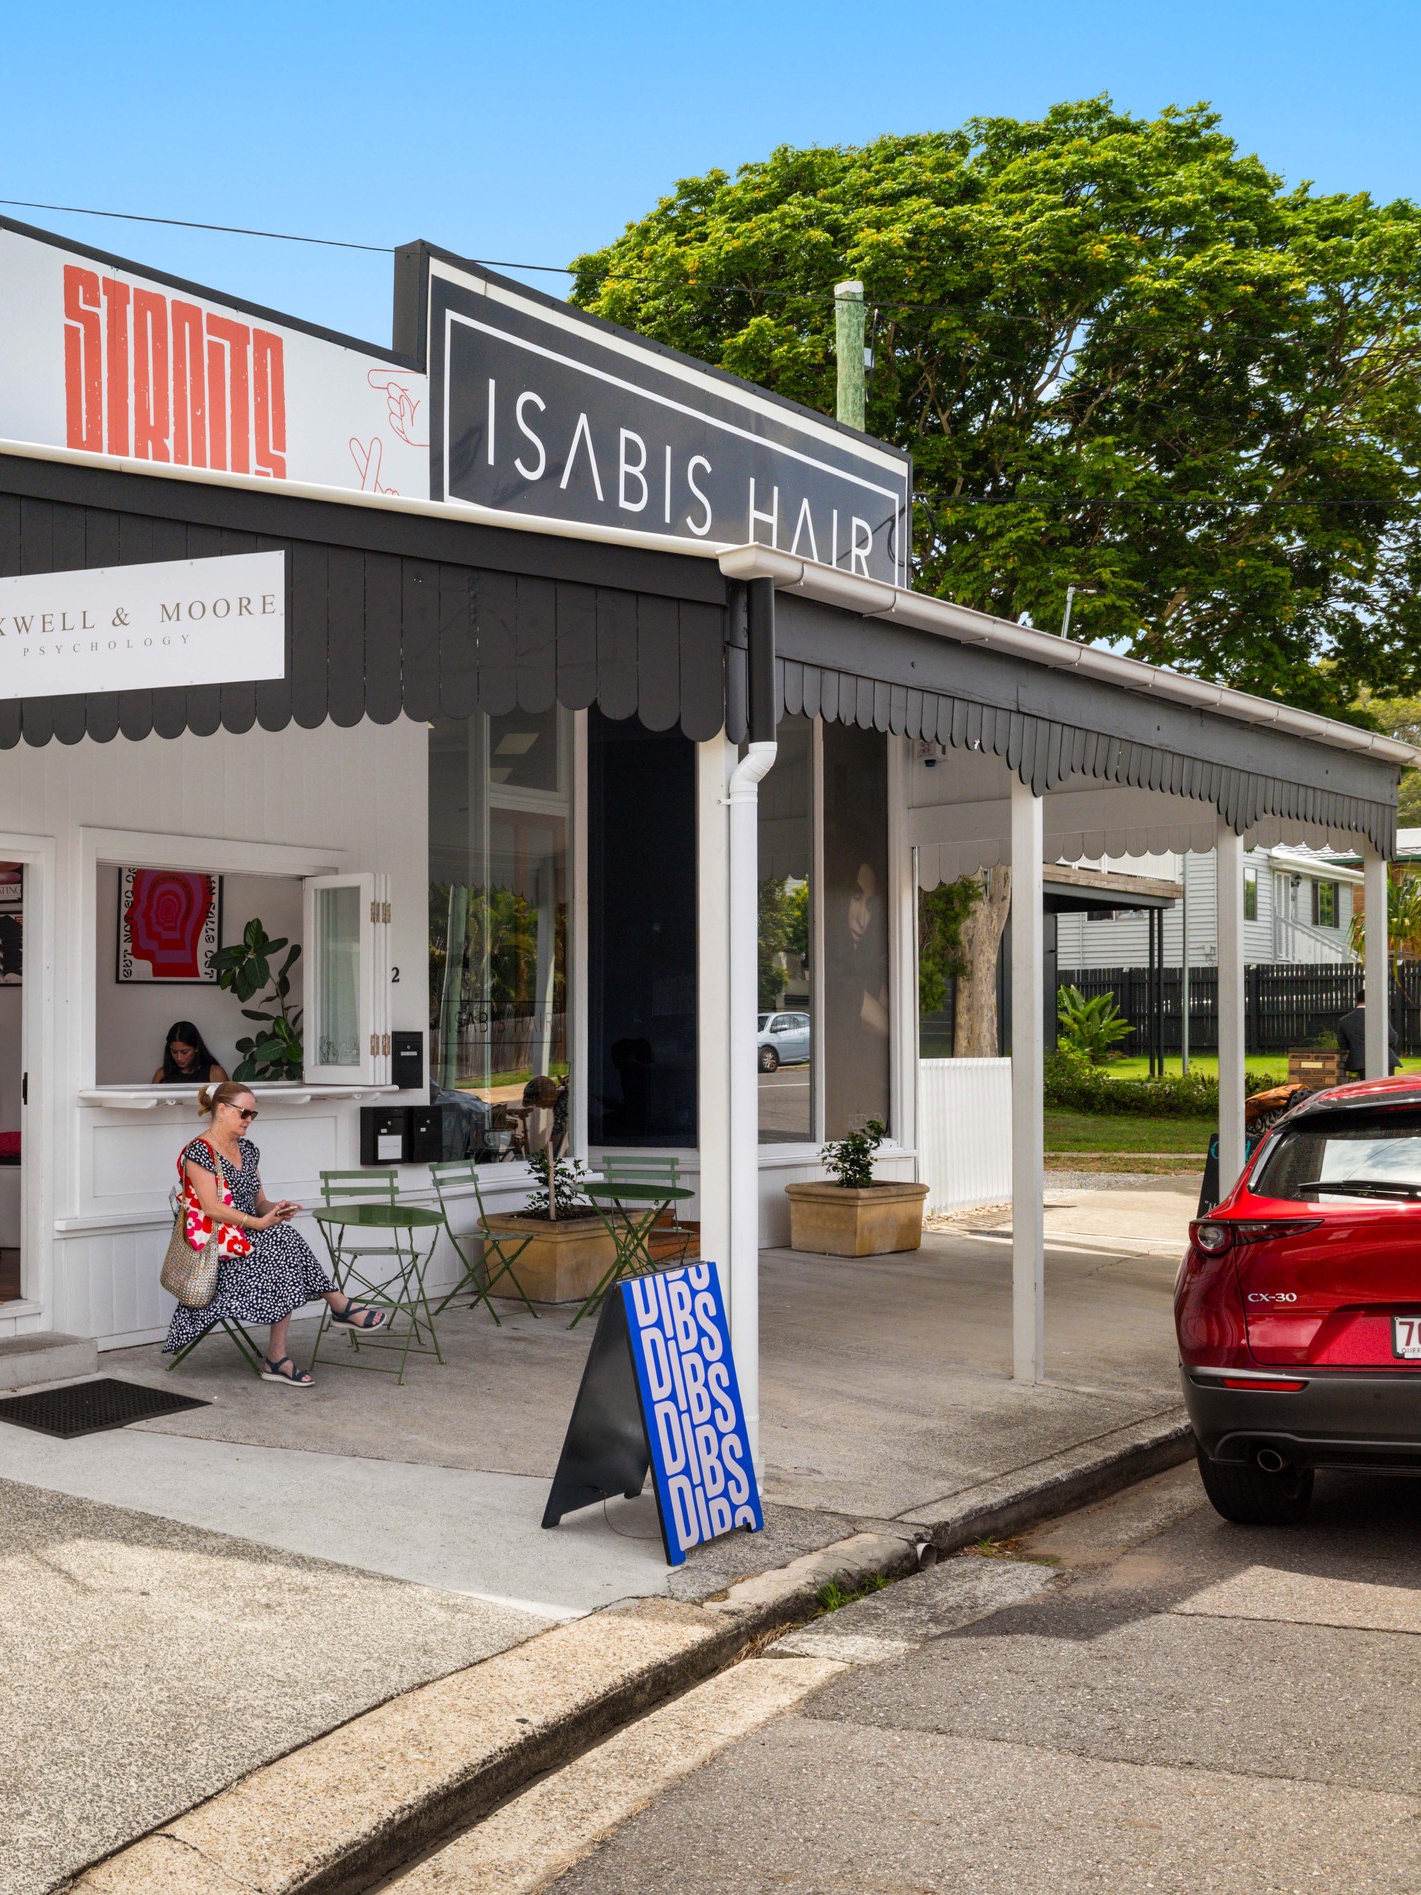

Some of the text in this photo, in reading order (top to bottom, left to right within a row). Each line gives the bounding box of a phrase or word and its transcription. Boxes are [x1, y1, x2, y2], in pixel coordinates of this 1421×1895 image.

[64, 264, 287, 480] STRAITS
[487, 378, 873, 579] ISABIS HAIR
[111, 606, 131, 627] &
[159, 593, 277, 624] MOORE
[22, 633, 191, 657] PSYCHOLOGY
[391, 966, 400, 983] 2
[449, 1011, 506, 1034] ISABS
[1247, 1292, 1298, 1303] CX-30
[1398, 1321, 1421, 1347] 7
[640, 1326, 737, 1434] DIBS
[653, 1400, 750, 1507] DIBS
